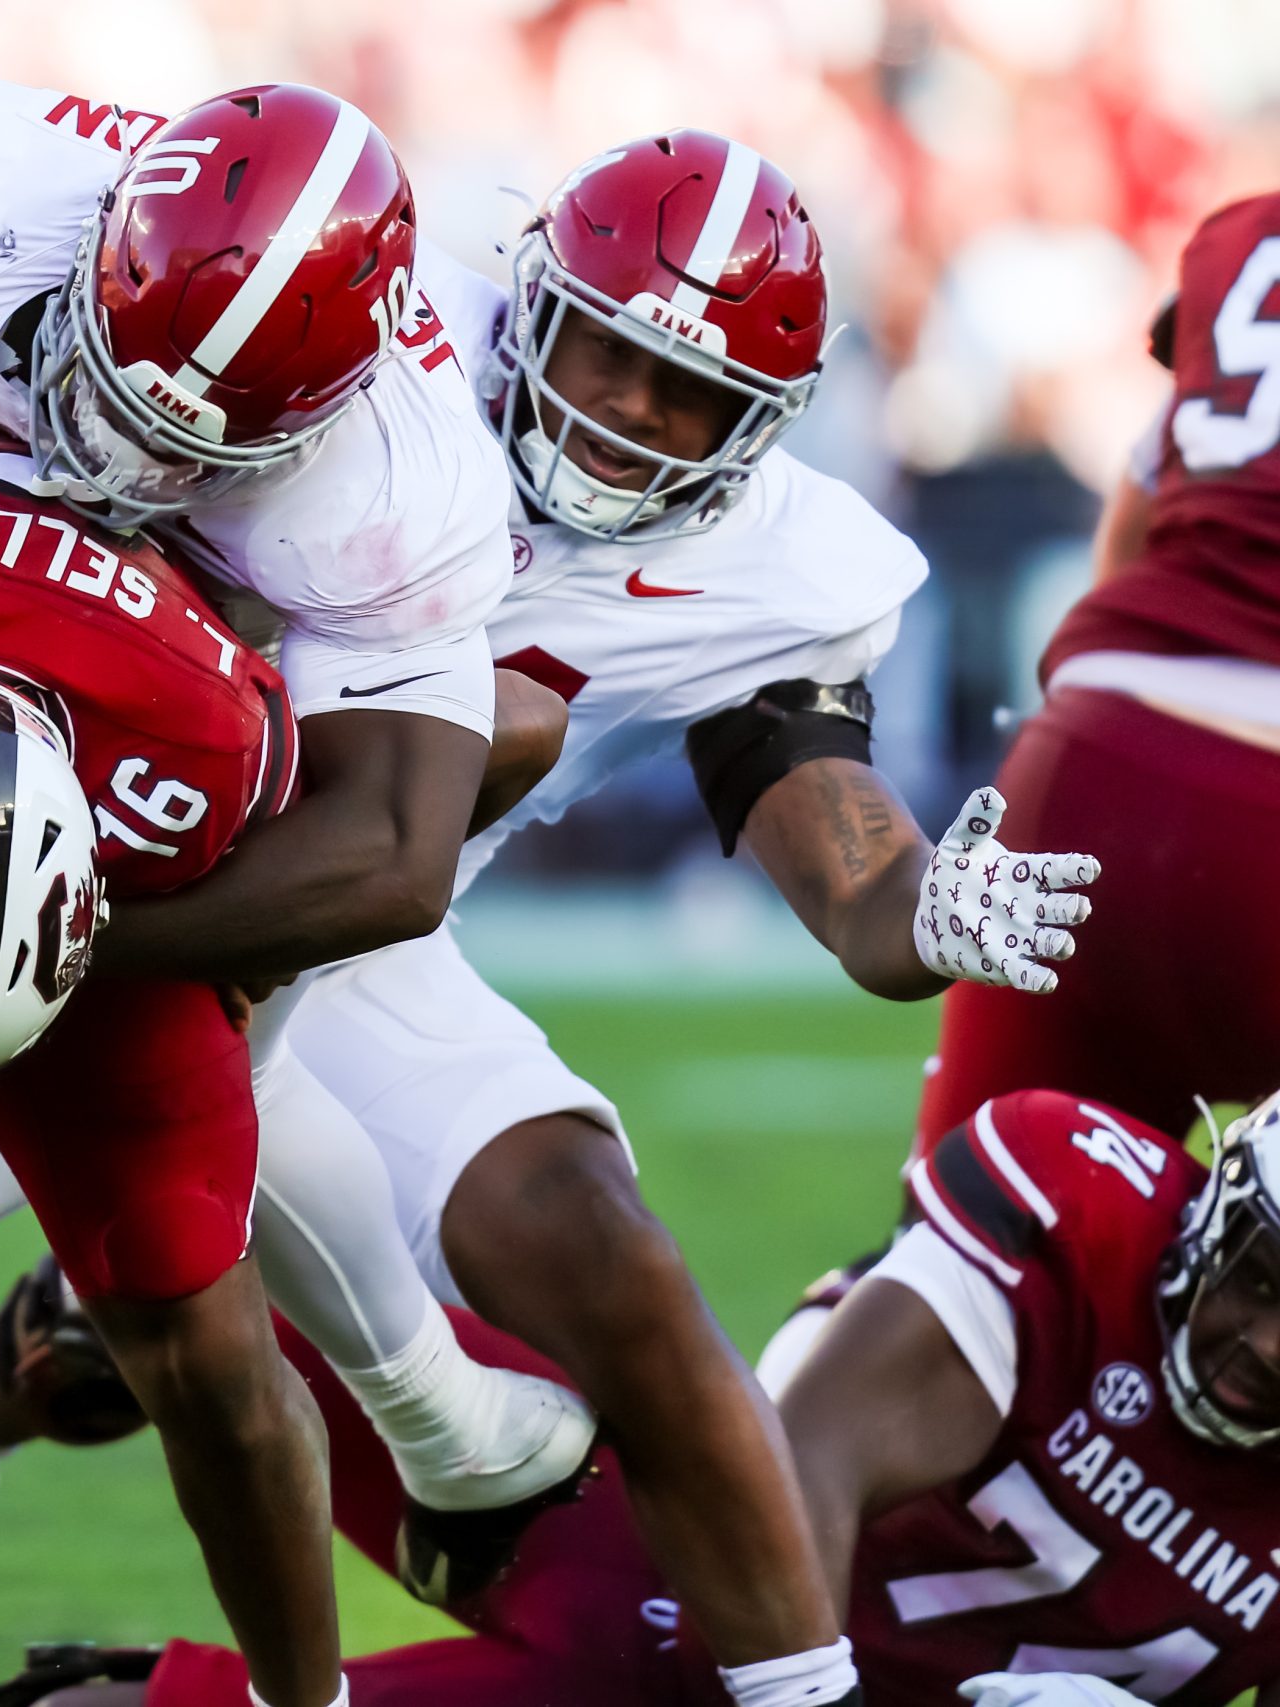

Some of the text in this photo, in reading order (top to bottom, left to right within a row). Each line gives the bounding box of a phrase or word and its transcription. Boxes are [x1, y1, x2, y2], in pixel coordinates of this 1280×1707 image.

[125, 136, 221, 198] 10
[368, 266, 409, 355] 10
[650, 306, 704, 345] BAMA
[146, 380, 201, 425] BAMA
[92, 757, 209, 858] 16
[1071, 1103, 1167, 1200] 74
[1096, 1366, 1150, 1420] SEC
[1047, 1409, 1280, 1631] CAROLINA
